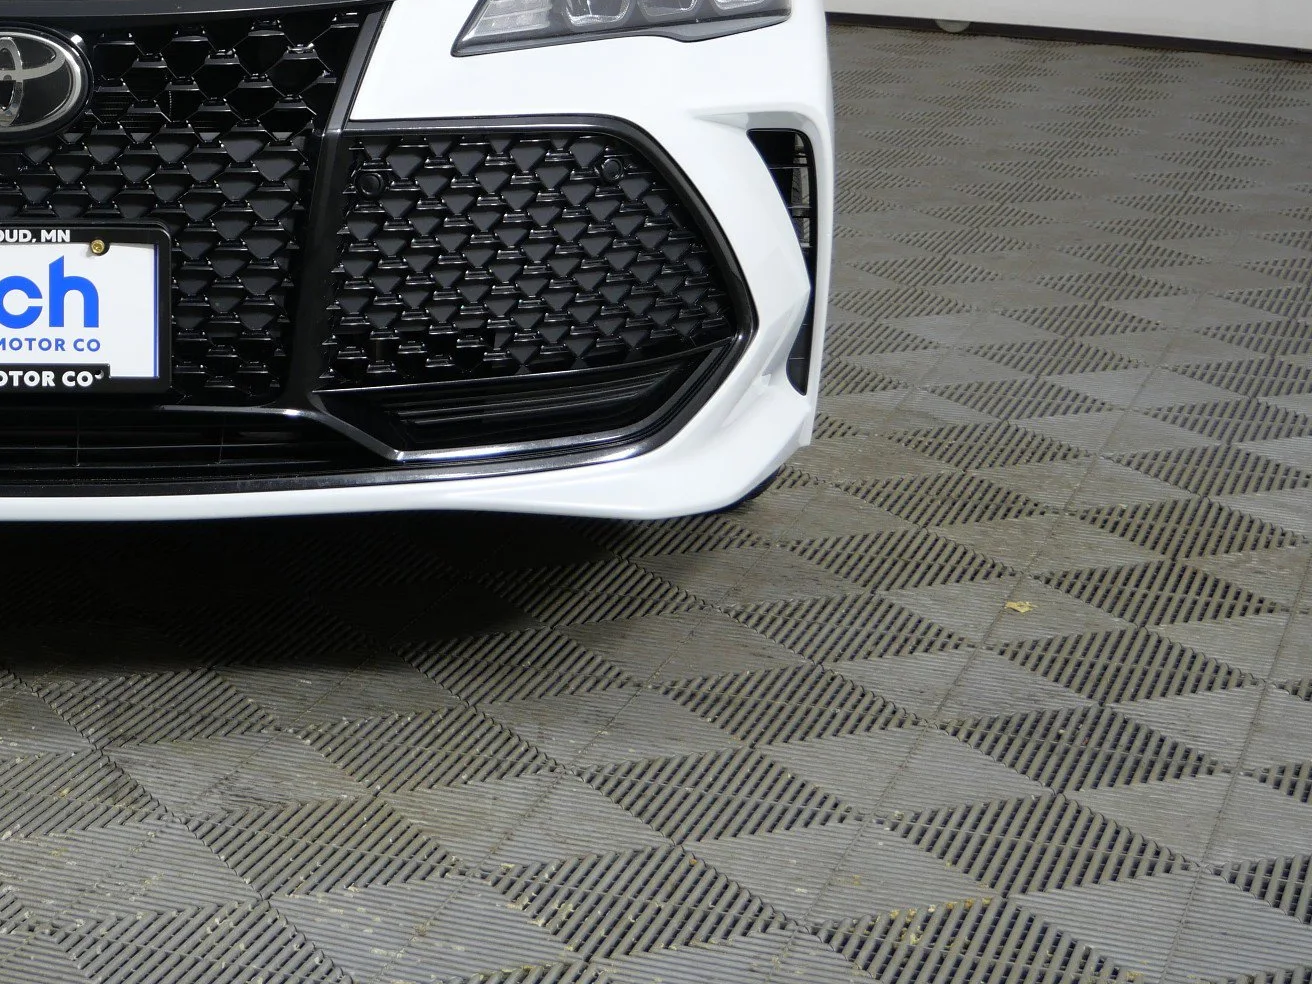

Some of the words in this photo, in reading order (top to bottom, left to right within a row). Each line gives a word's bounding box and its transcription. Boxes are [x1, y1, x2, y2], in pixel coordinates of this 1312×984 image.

[41, 229, 71, 243] MN
[73, 337, 101, 352] CO
[61, 370, 93, 387] CO
